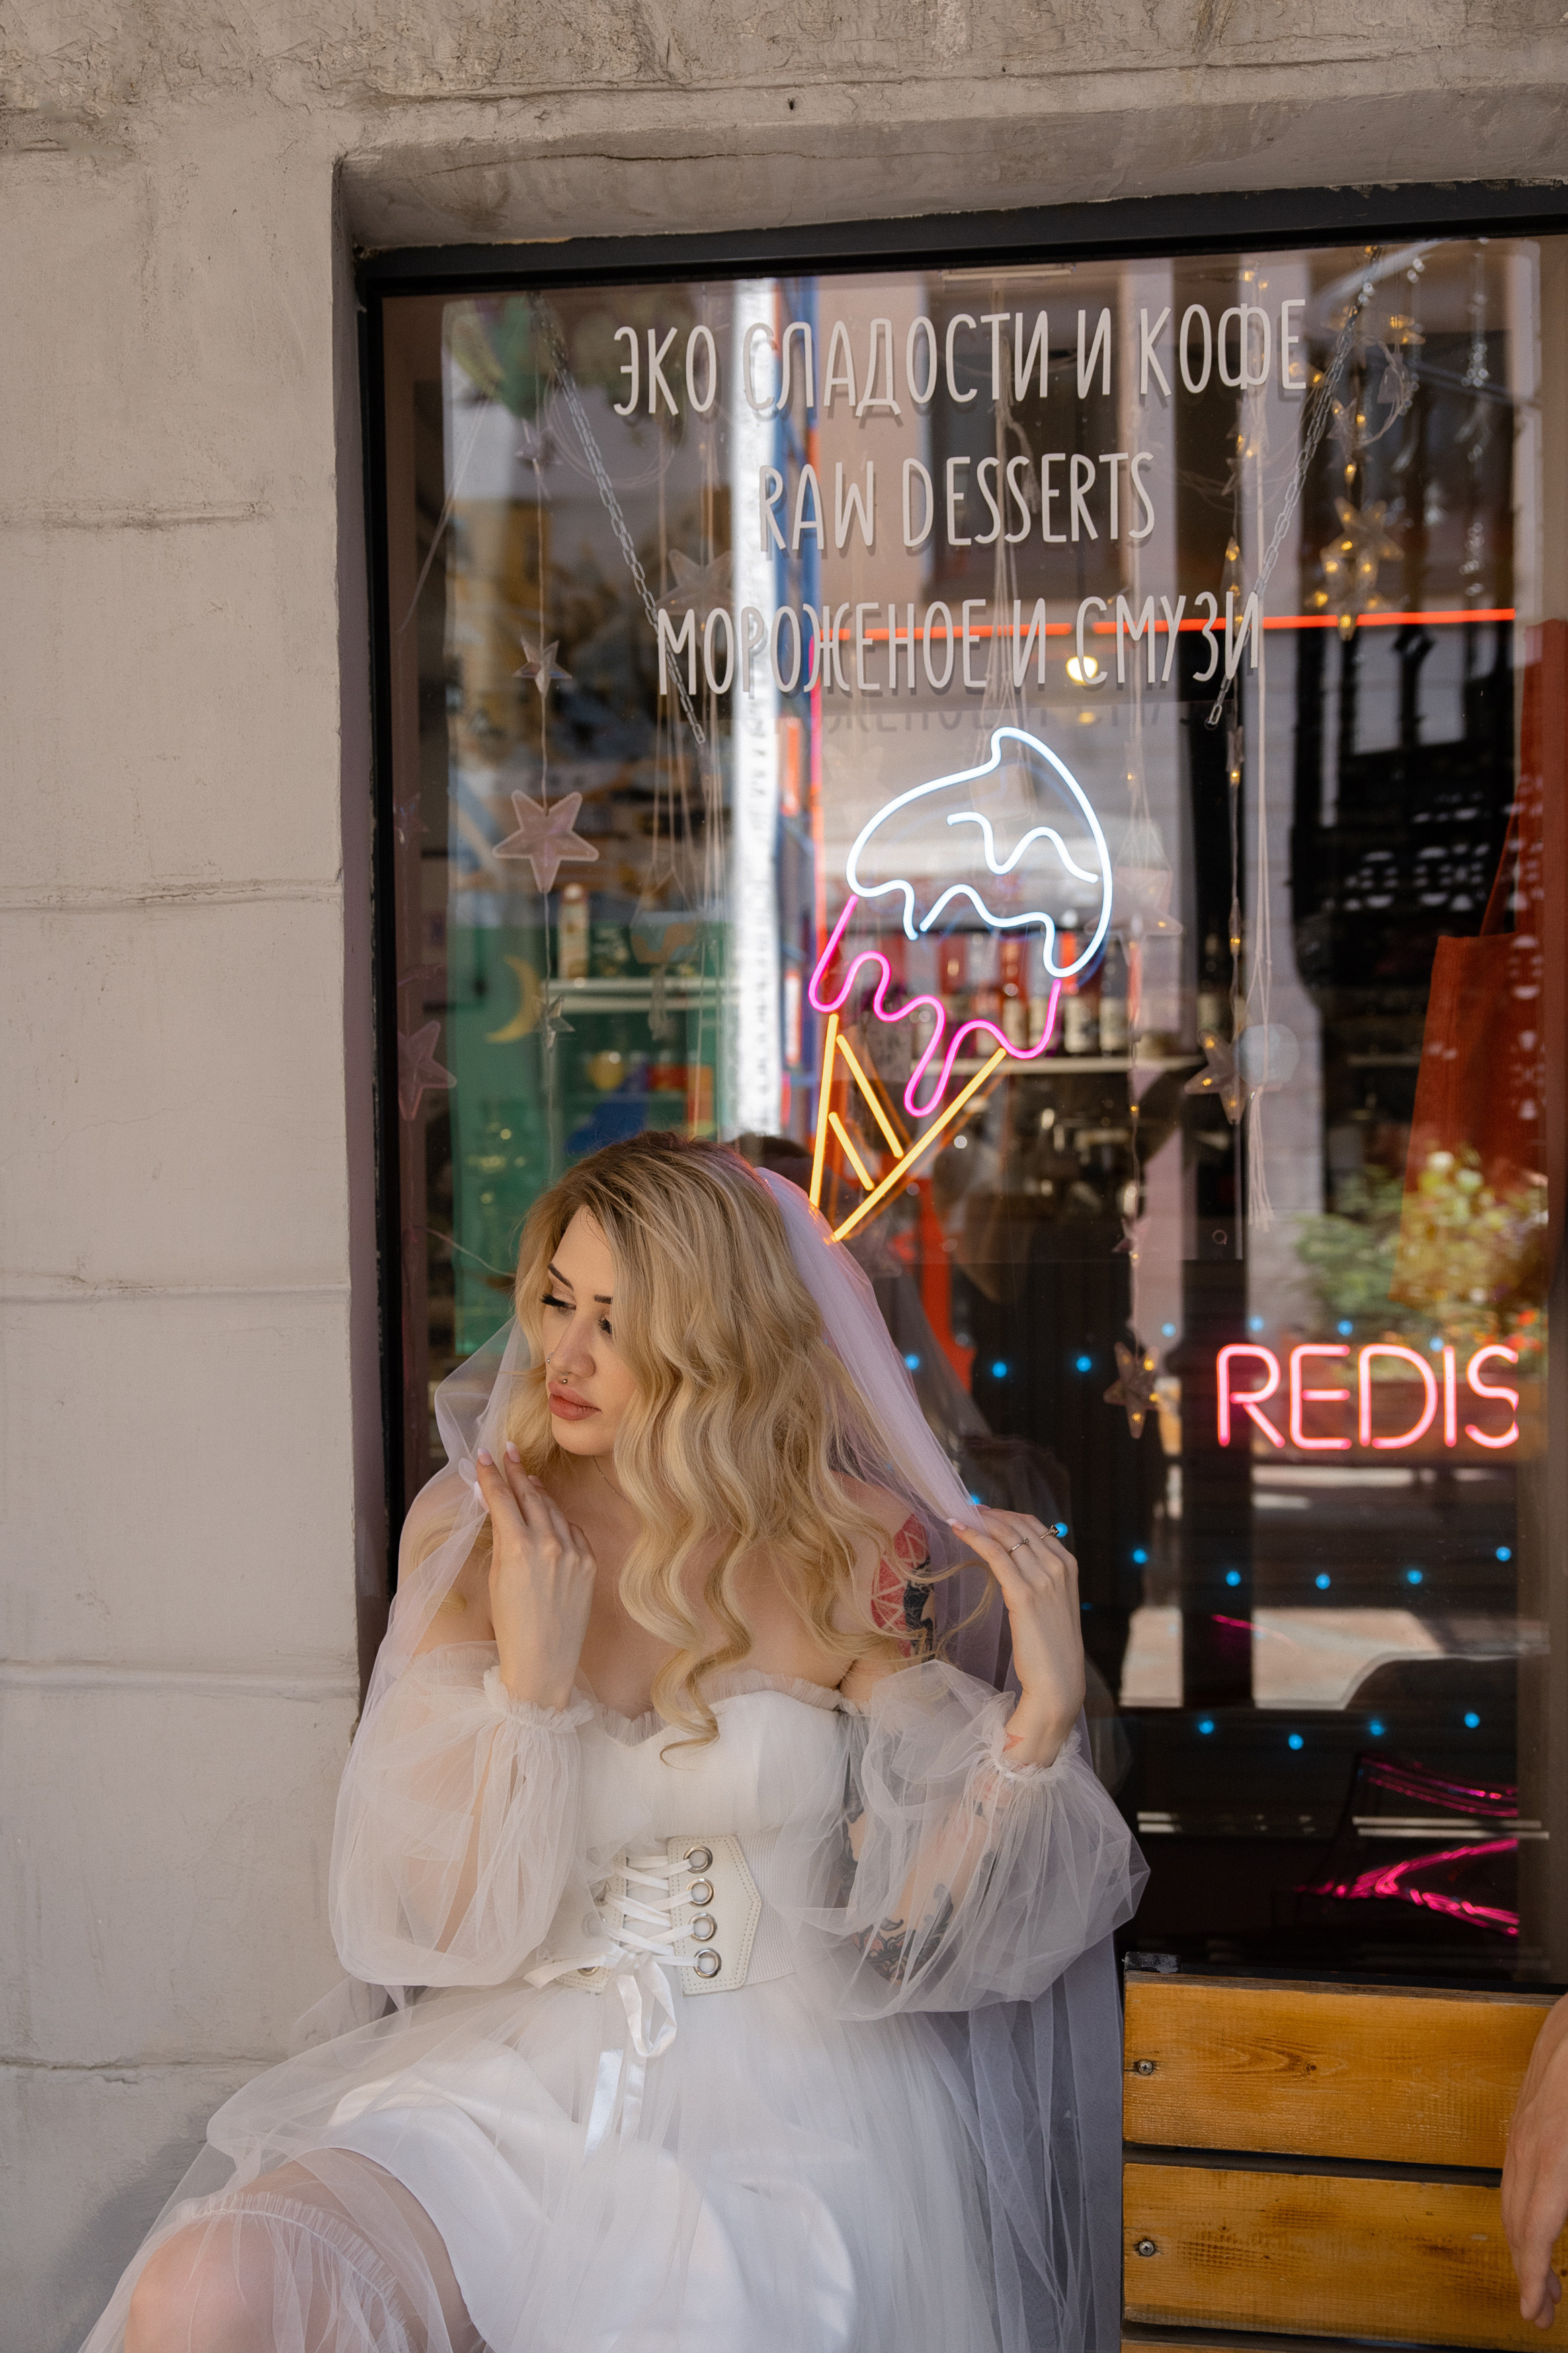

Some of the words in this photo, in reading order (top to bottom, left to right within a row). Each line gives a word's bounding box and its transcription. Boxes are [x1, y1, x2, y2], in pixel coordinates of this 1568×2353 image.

[613, 324, 717, 416] ЭКО
[743, 310, 1048, 417] СЛАДОСТИ
[1077, 307, 1112, 399] И
[1140, 298, 1307, 397] КОФЕ
[759, 460, 874, 552] RAW
[902, 451, 1155, 547] DESSERTS
[657, 598, 988, 696] МОРОЖЕНОЕ
[1012, 597, 1046, 688] И
[1075, 590, 1260, 685] СМУЗИ
[1216, 1343, 1520, 1450] REDIS
